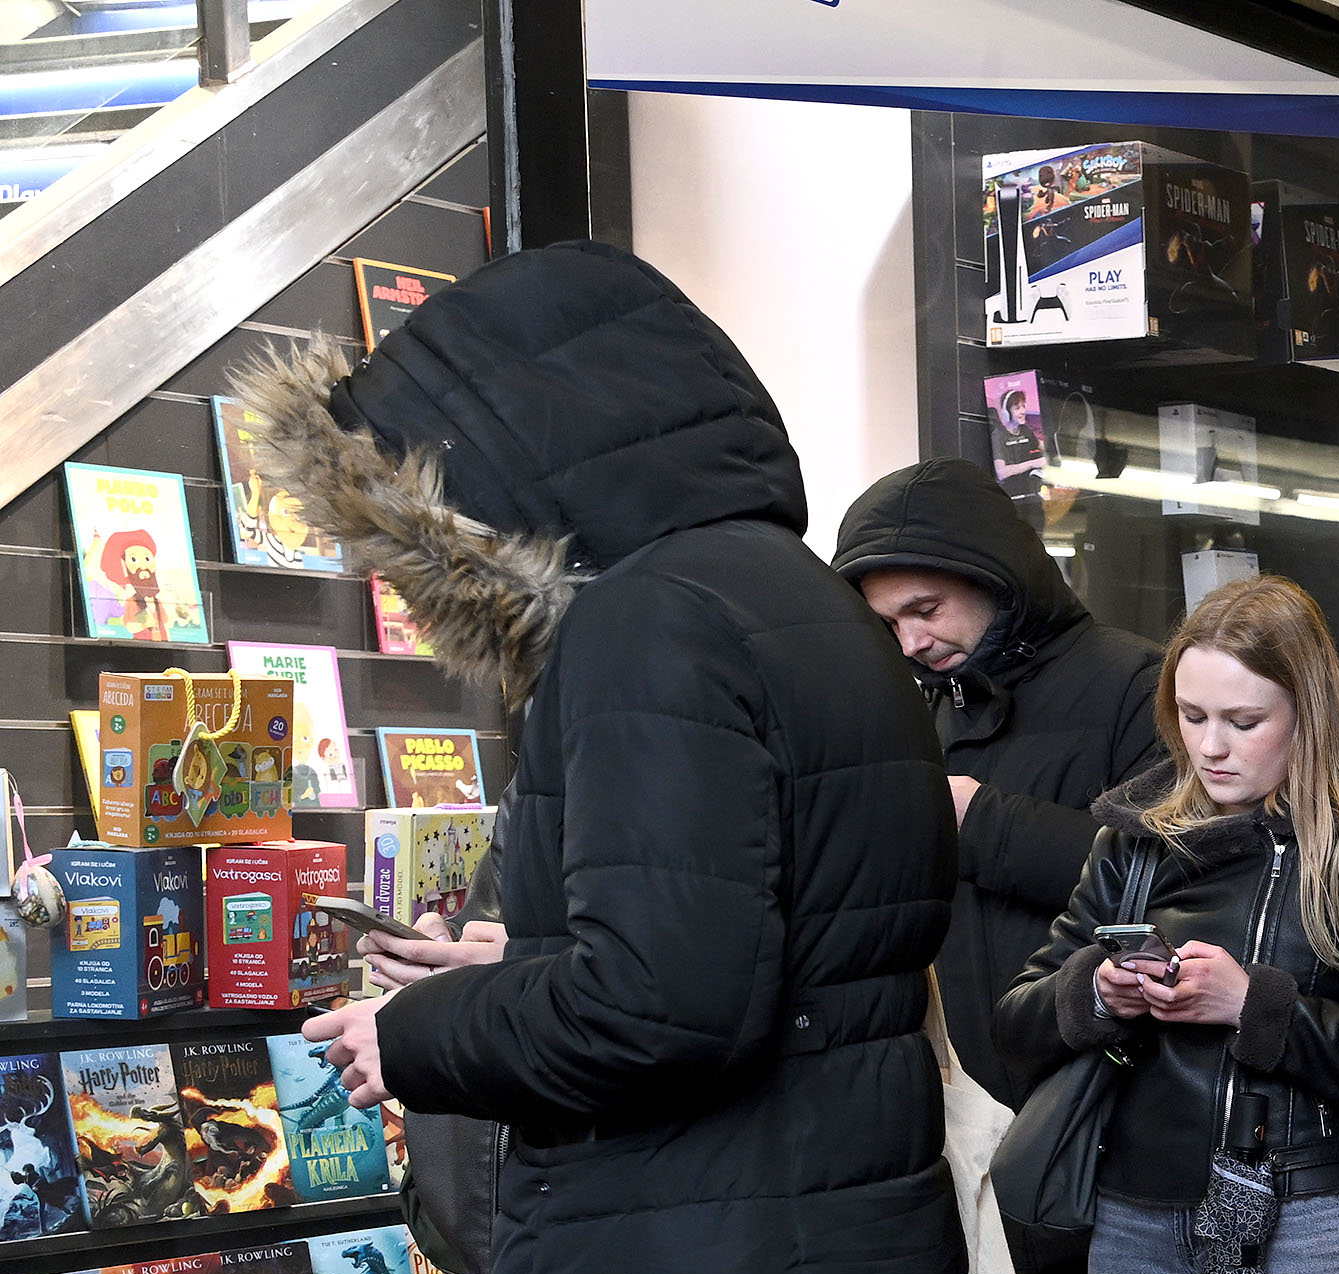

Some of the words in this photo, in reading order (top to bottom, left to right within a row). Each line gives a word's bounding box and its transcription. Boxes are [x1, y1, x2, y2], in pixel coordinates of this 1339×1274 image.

[1084, 203, 1129, 220] SPIDER-MAN
[1166, 183, 1231, 225] SPIDER-MAN
[1089, 270, 1122, 285] PLAY
[263, 656, 307, 670] MARIE
[102, 691, 134, 708] ABECEDA
[272, 720, 284, 731] 20
[405, 737, 455, 754] PABLO
[400, 754, 465, 772] PICASSO
[151, 790, 178, 807] ABC
[381, 838, 395, 854] 3D
[65, 871, 122, 887] Vlakovi
[153, 871, 189, 892] Vlakovi
[213, 868, 282, 884] Vatrogasci
[295, 866, 341, 890] Vatrogasci
[375, 868, 390, 902] dvorac
[80, 1053, 96, 1065] J.K.
[99, 1049, 154, 1062] ROWLING
[183, 1047, 200, 1058] J.K.
[201, 1042, 254, 1056] ROWLING
[79, 1067, 119, 1096] Harry
[118, 1061, 161, 1093] Potter
[182, 1059, 219, 1088] Harry
[218, 1055, 259, 1079] Potter
[288, 1128, 369, 1160] PLAMENA
[306, 1155, 360, 1188] KRILA
[338, 1235, 372, 1246] SUTHERLAND
[237, 1246, 293, 1263] ROWLING
